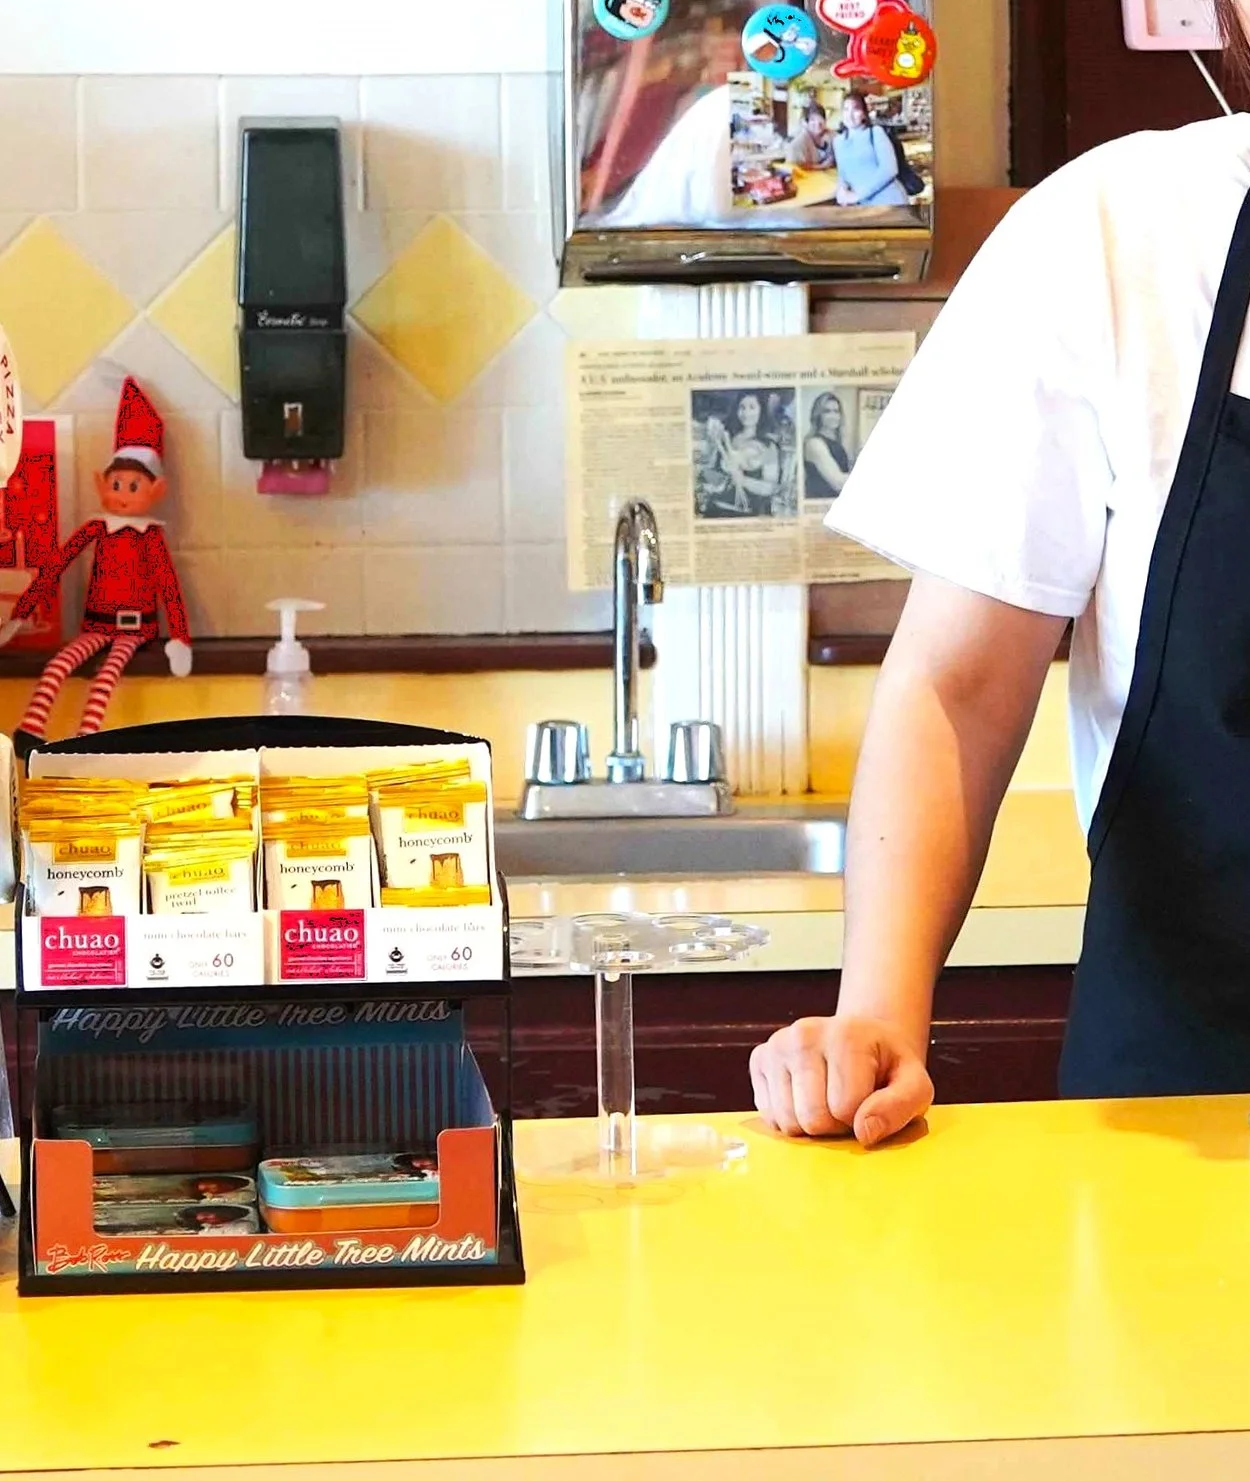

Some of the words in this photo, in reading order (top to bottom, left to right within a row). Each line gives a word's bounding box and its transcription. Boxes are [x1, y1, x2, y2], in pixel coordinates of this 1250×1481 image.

[399, 832, 472, 848] honeycomb
[59, 842, 112, 855] chuao
[47, 866, 122, 881] honeycomb
[280, 862, 354, 875] honeycomb
[45, 926, 119, 950] chuao
[285, 920, 359, 943] chuao
[212, 953, 234, 968] 60
[451, 946, 473, 961] 60
[52, 1007, 167, 1043] Happy
[176, 1005, 266, 1029] Little
[353, 1000, 450, 1023] Mints
[135, 1244, 239, 1272] Happy
[245, 1241, 325, 1268] Little
[333, 1239, 394, 1265] Tree
[401, 1235, 486, 1262] Mints
